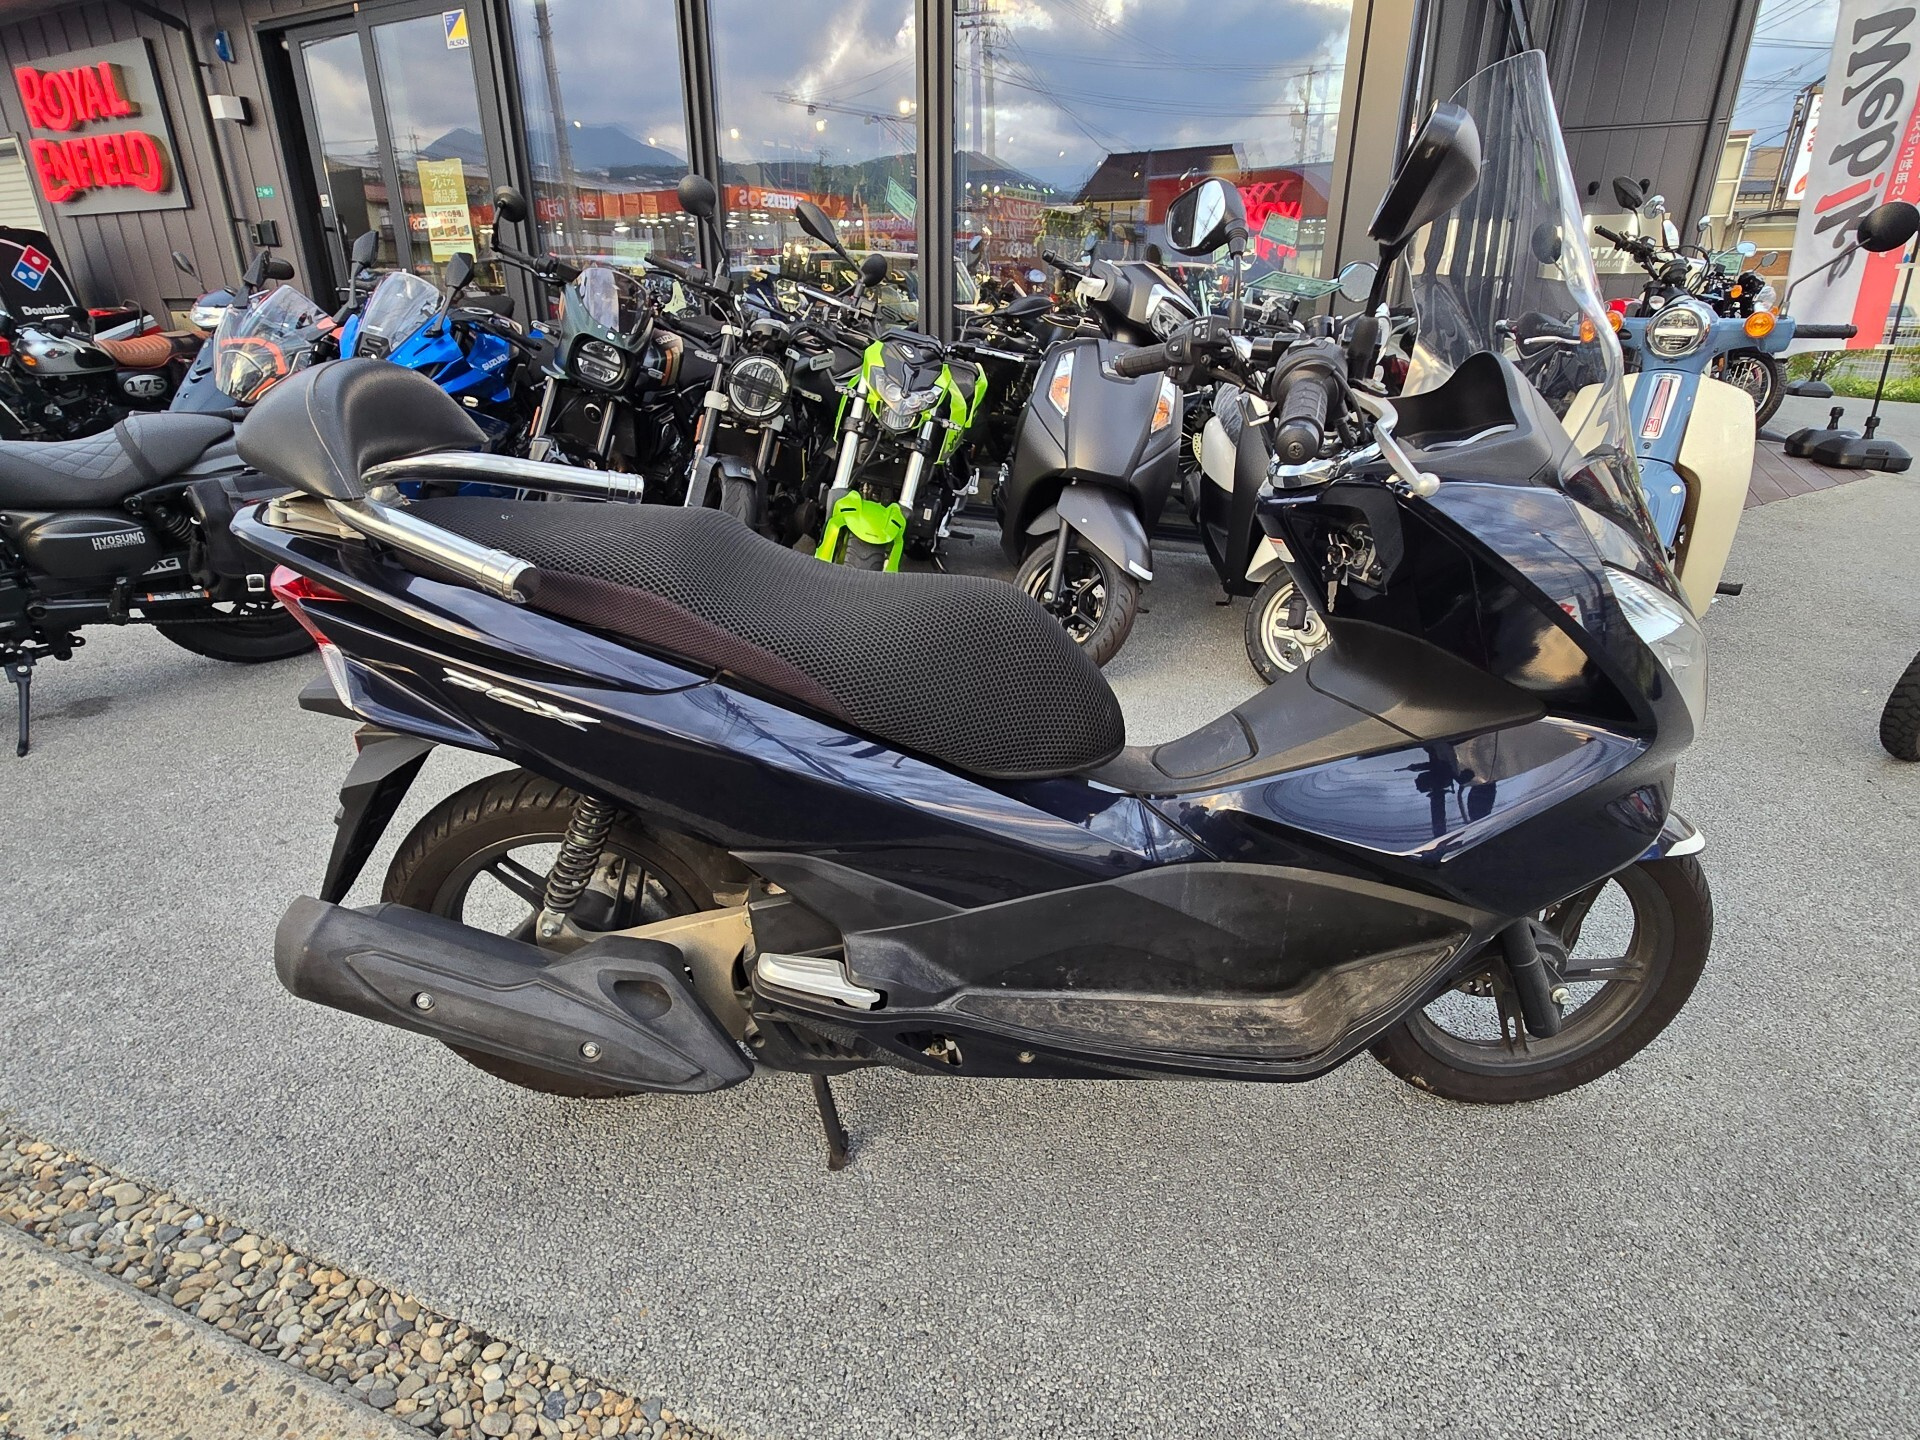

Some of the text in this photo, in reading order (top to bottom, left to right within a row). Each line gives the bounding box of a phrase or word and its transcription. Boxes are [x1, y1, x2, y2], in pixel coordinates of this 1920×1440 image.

[14, 61, 131, 131] ROYAL
[29, 131, 163, 203] ENFIELD
[430, 178, 456, 189] プレミアム
[432, 188, 458, 203] 商品券
[127, 378, 165, 395] 175
[91, 531, 146, 551] HYOSUNG
